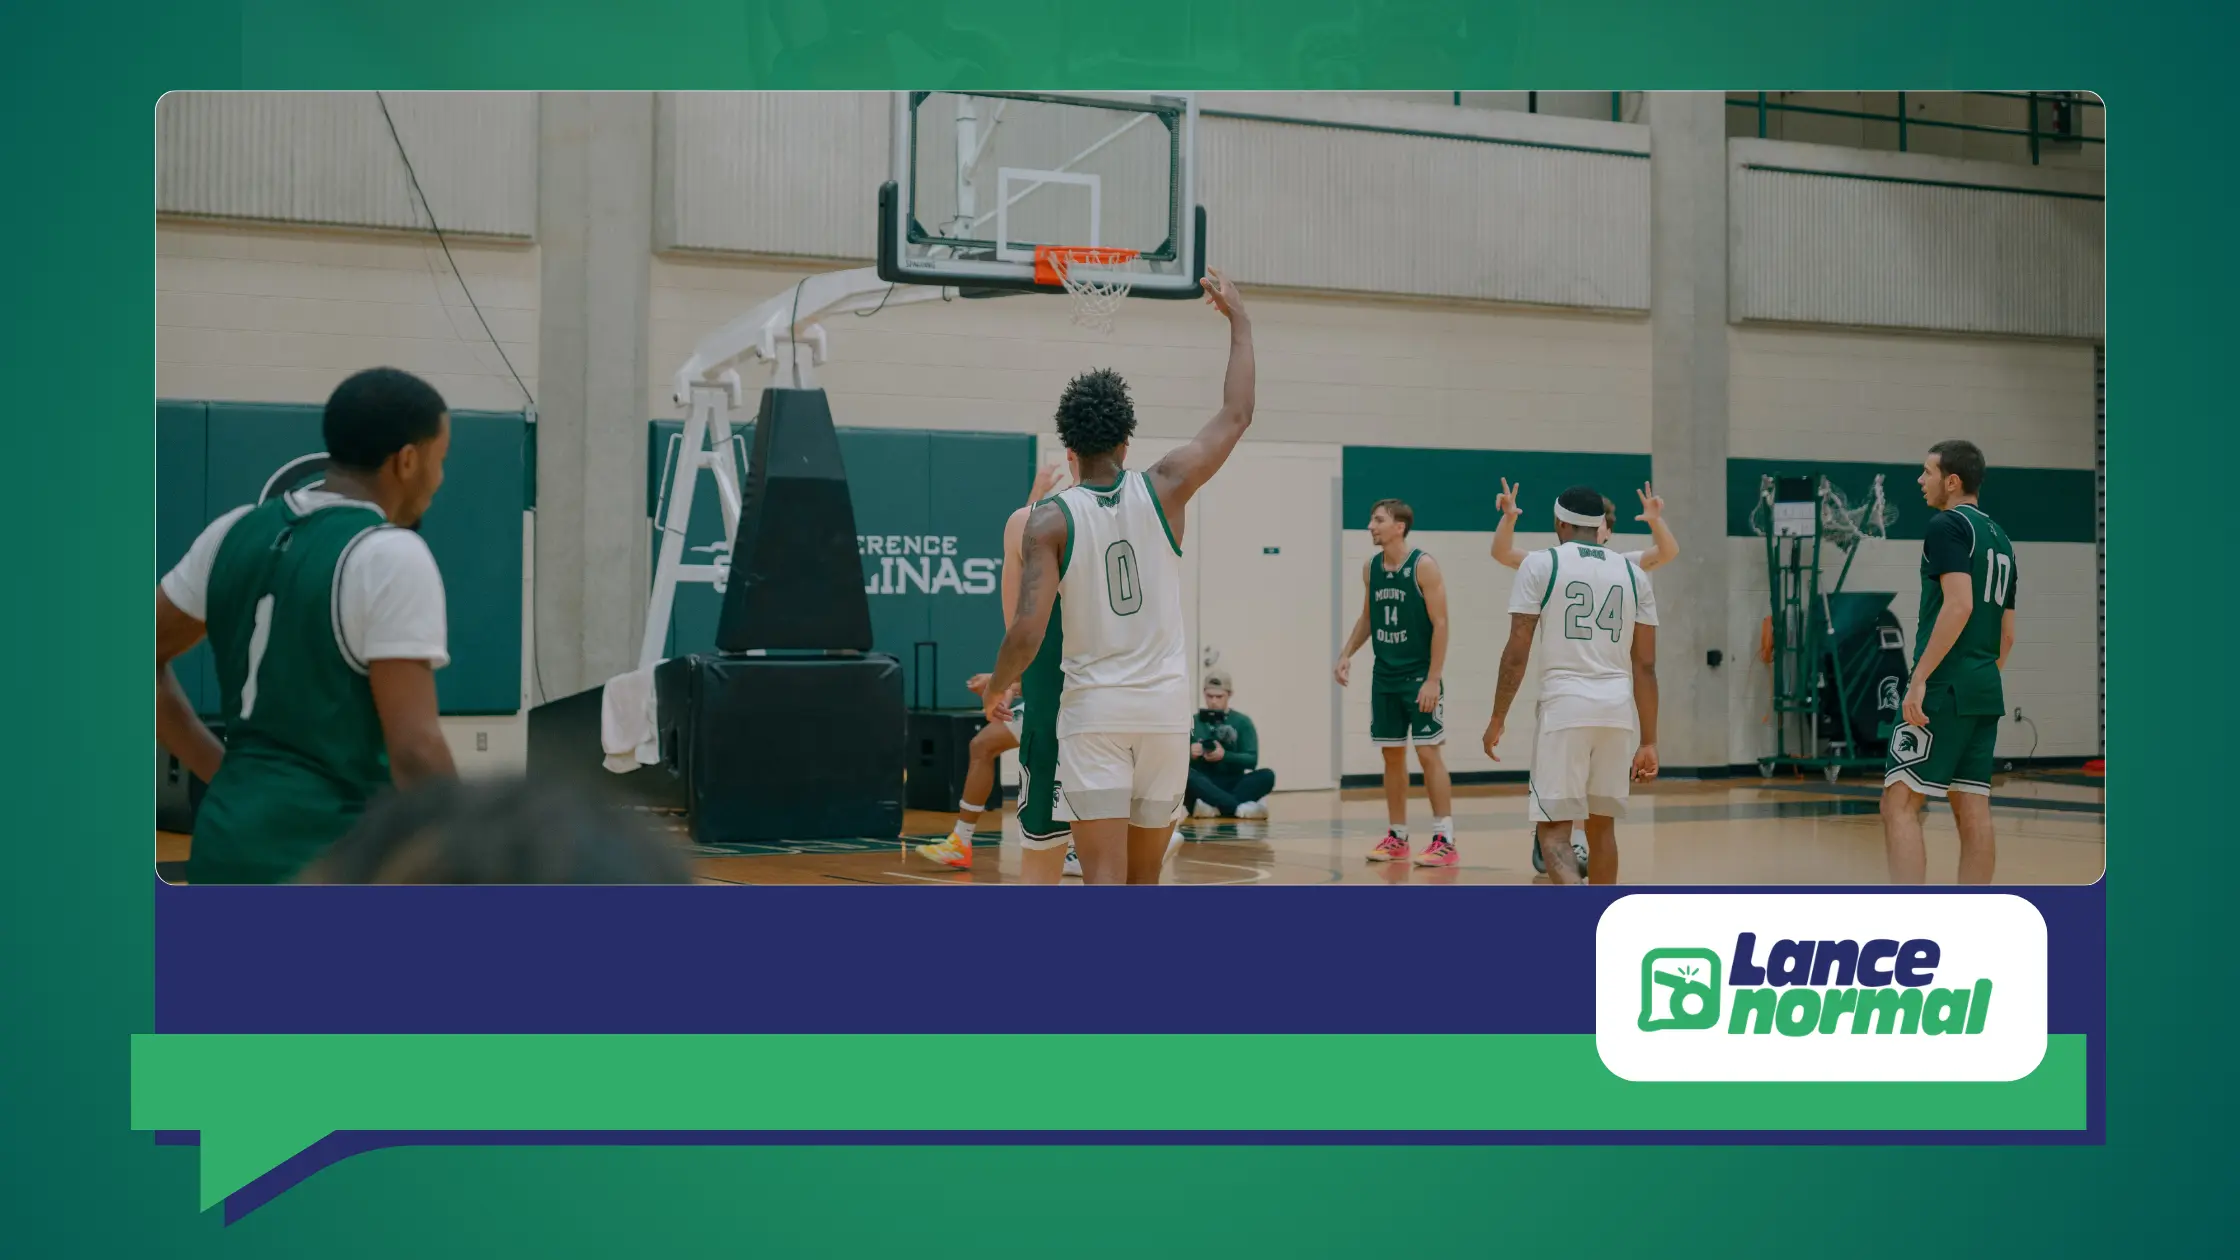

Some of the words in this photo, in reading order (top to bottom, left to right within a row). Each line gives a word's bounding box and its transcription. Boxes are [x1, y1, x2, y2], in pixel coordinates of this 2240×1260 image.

[1105, 539, 1143, 617] 0
[1375, 588, 1406, 602] MOUNT
[1984, 548, 2011, 607] 10
[1377, 629, 1407, 643] OLIVE
[1384, 605, 1398, 626] 14
[1565, 581, 1623, 643] 24
[240, 593, 275, 719] 1
